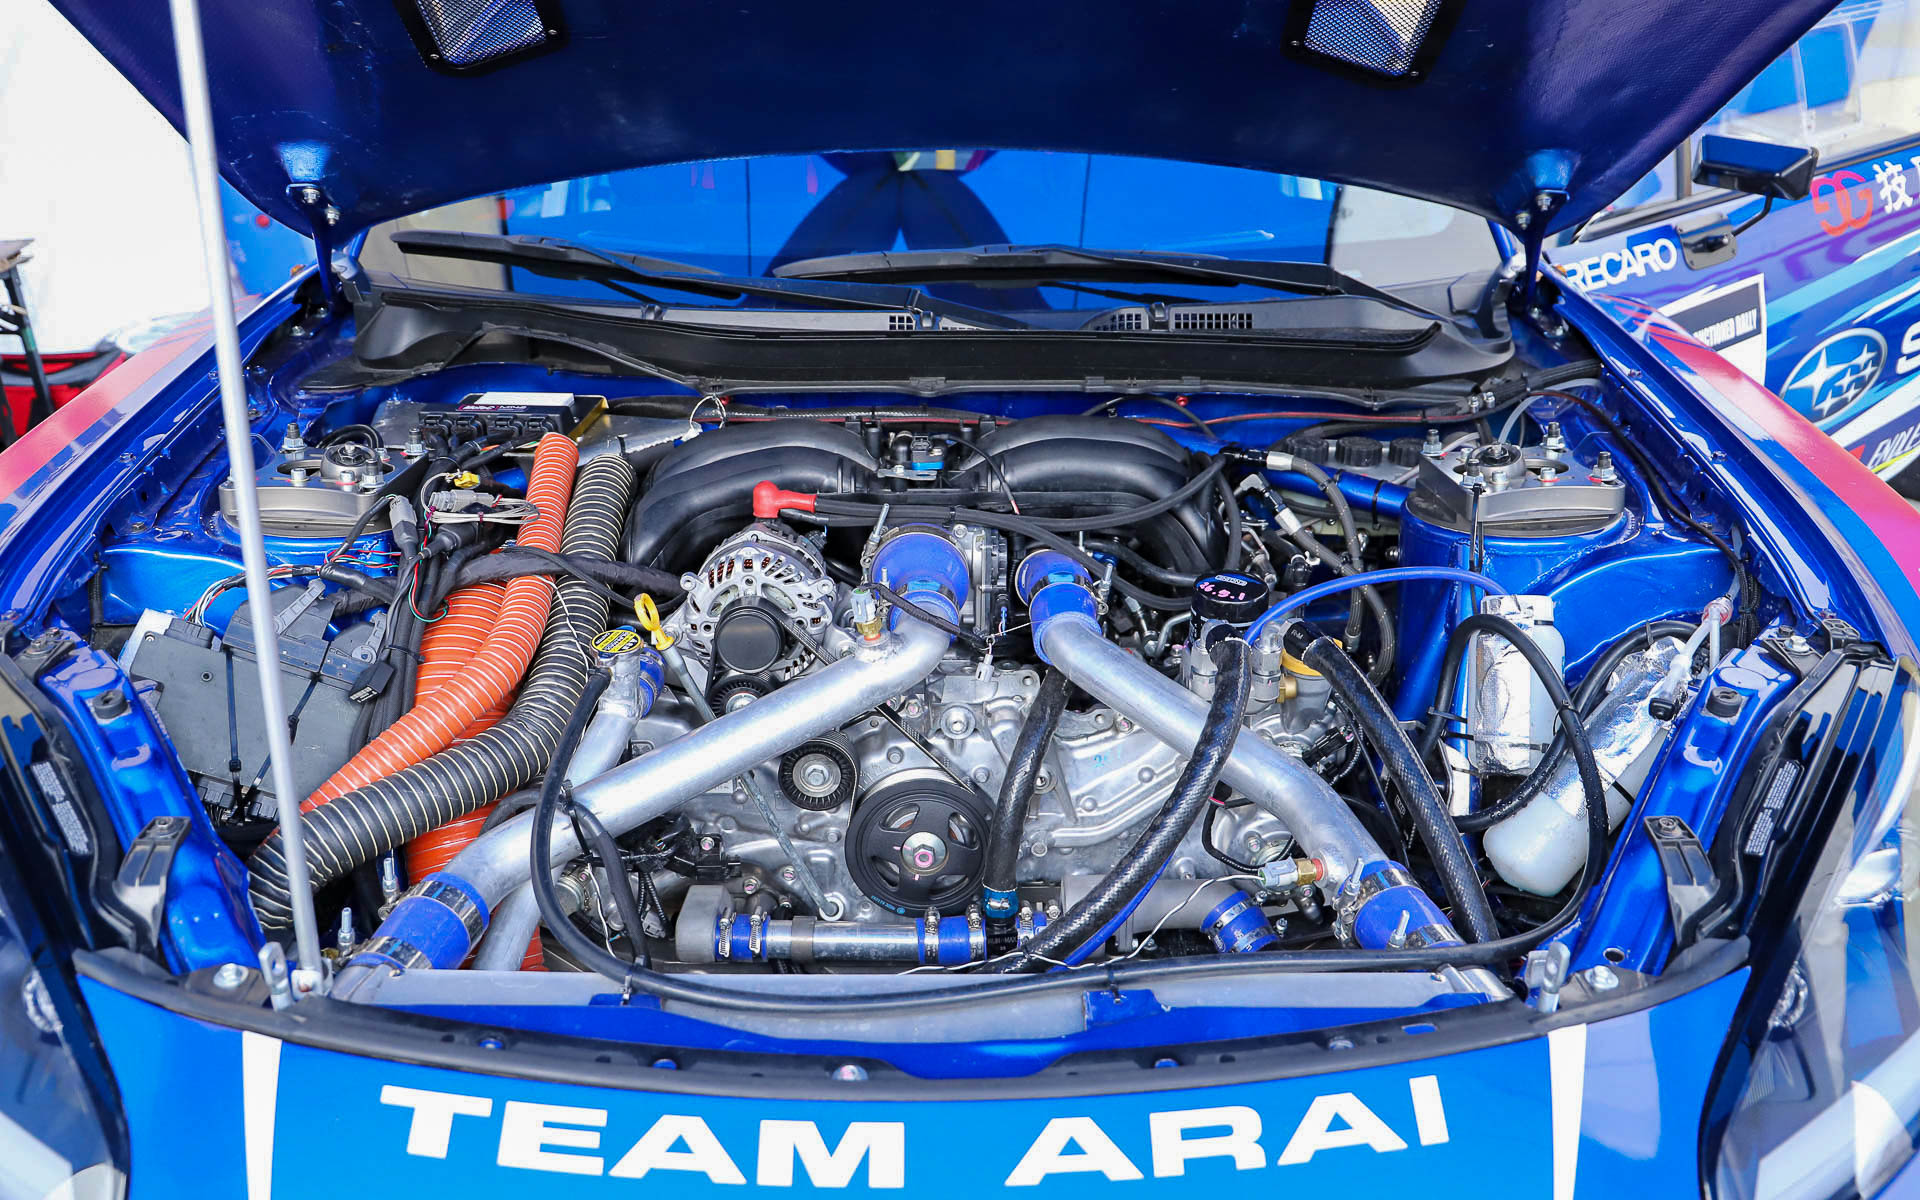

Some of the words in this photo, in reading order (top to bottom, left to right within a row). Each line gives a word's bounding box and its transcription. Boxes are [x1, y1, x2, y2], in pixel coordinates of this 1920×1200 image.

[1872, 155, 1920, 214] 技
[1558, 238, 1678, 291] RECARO
[380, 1085, 905, 1188] TEAM
[1004, 1074, 1450, 1186] ARAI
